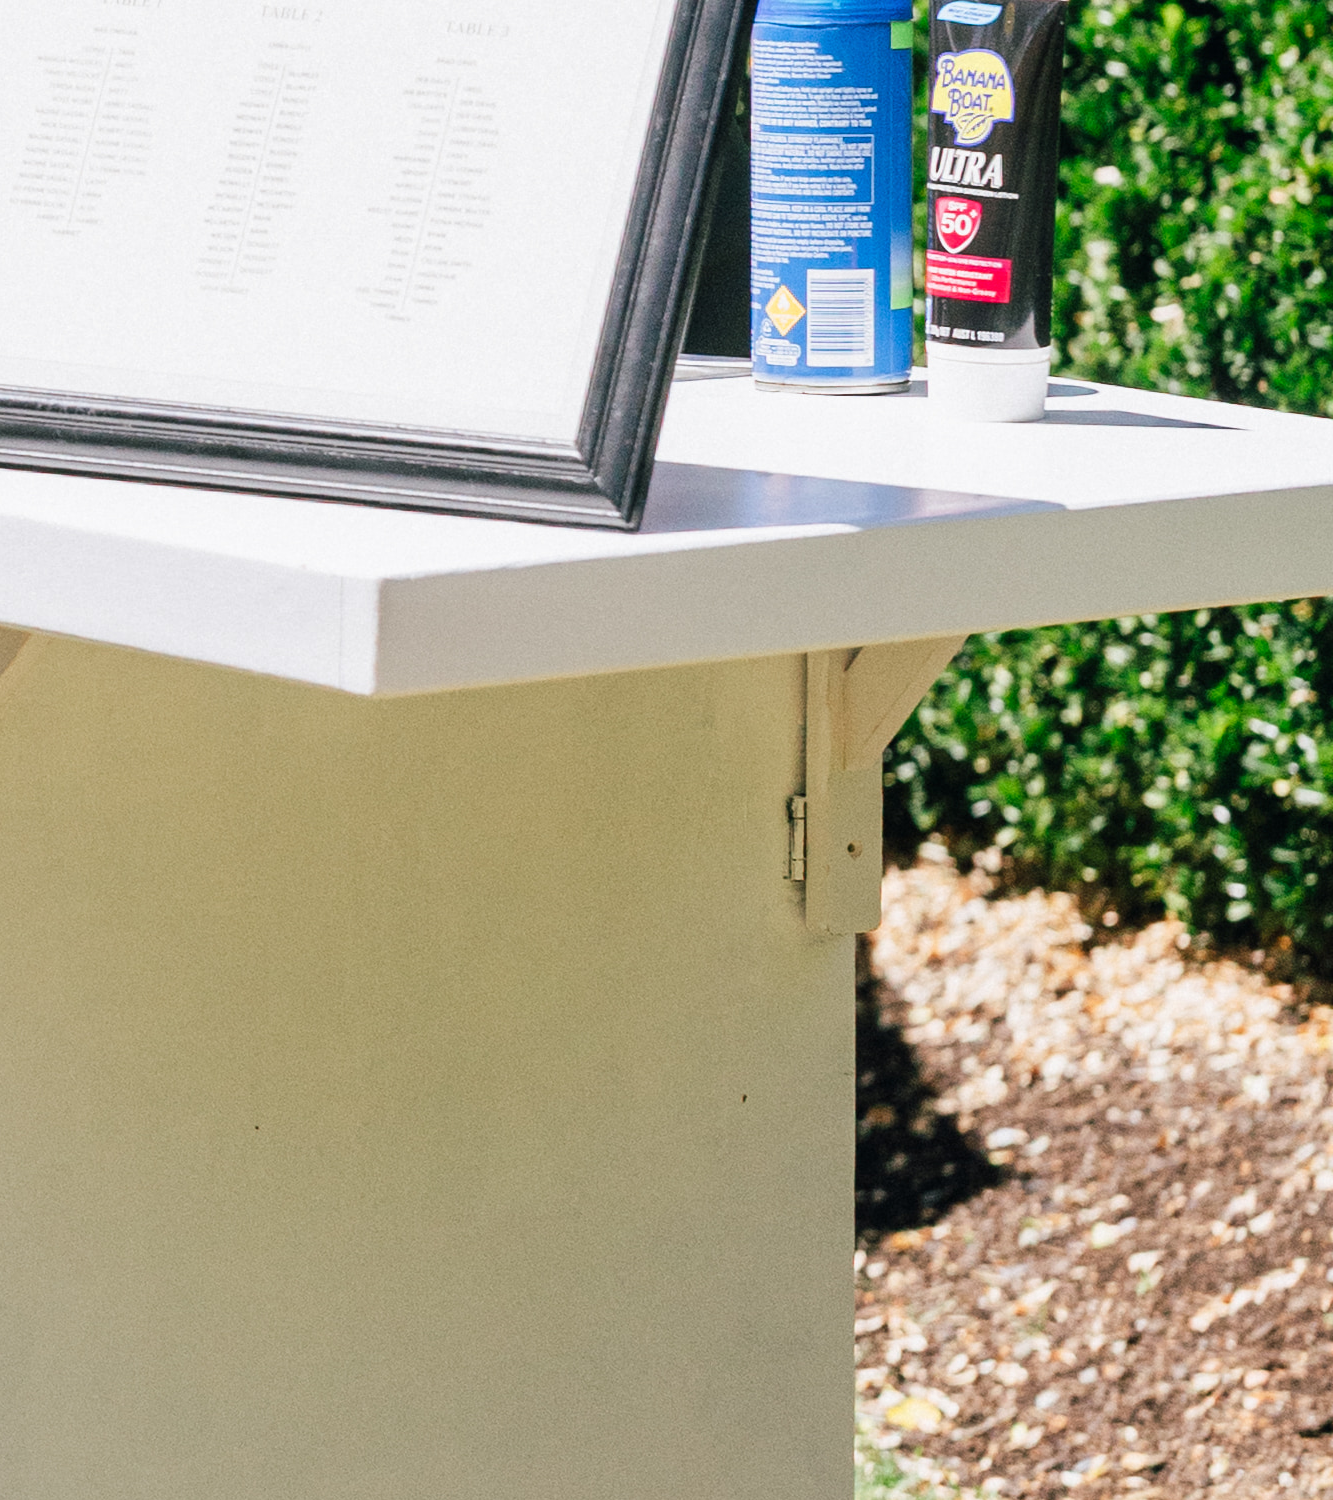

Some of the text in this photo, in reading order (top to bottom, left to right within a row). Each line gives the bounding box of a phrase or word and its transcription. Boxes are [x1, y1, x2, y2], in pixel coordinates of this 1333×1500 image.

[261, 4, 311, 21] TABLE
[445, 20, 496, 36] TABLE
[929, 146, 1004, 188] ULTRA
[947, 201, 969, 213] SPF
